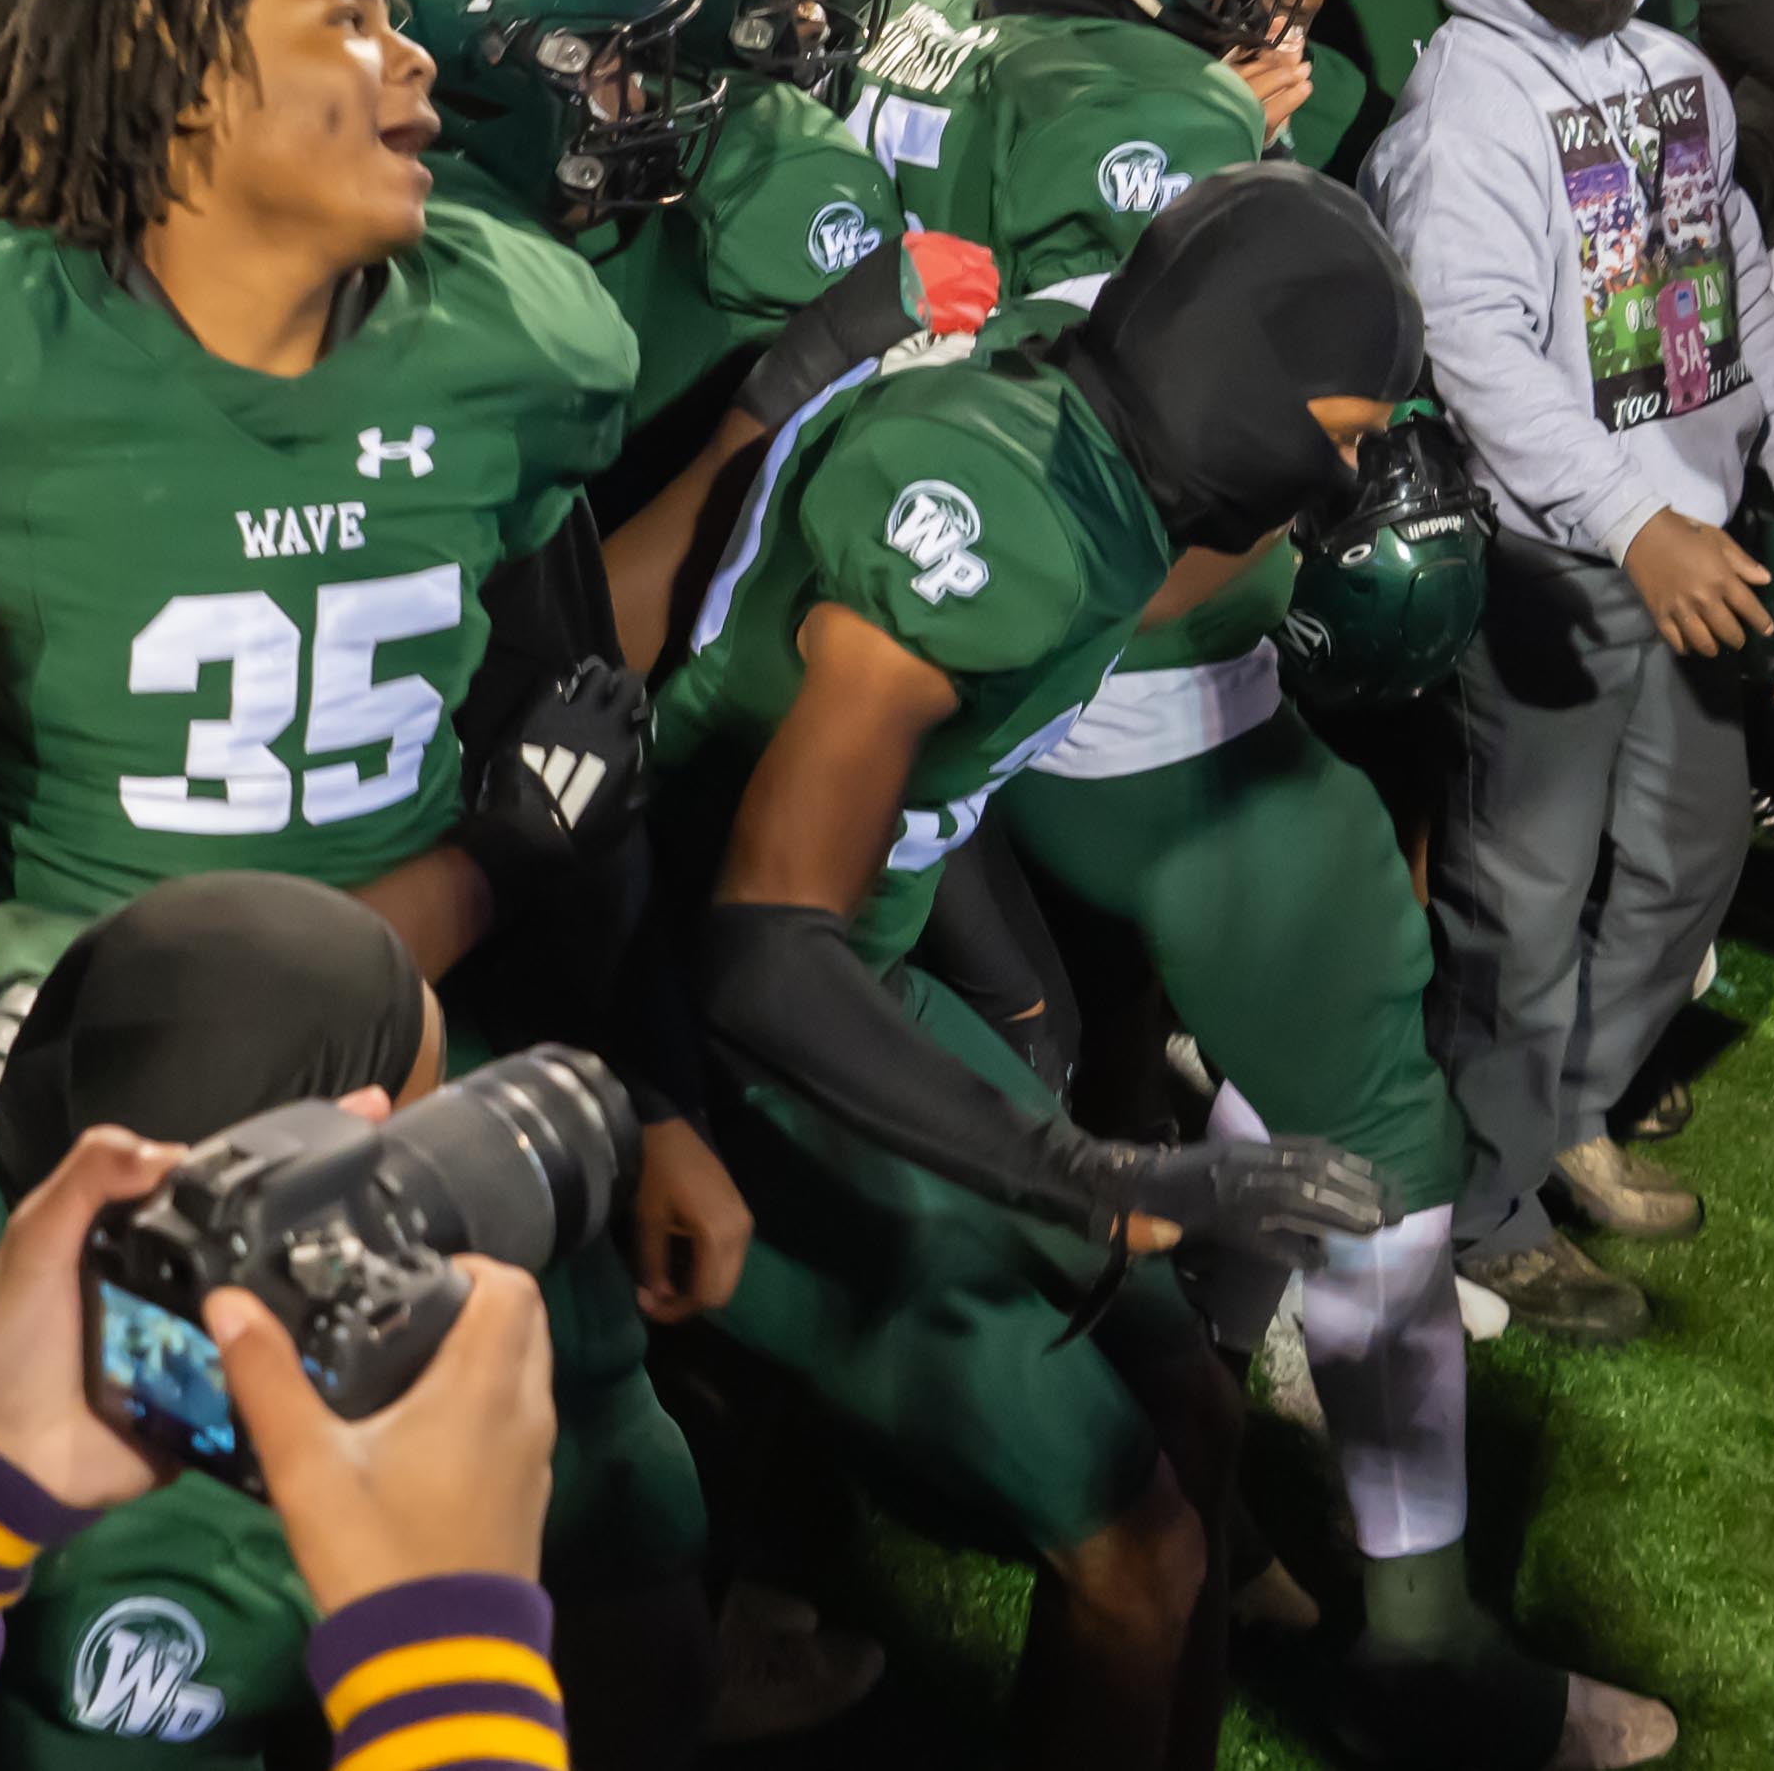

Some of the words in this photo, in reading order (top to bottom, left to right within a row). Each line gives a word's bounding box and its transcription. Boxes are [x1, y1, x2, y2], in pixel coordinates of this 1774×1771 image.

[234, 501, 367, 559] WAVE
[887, 479, 990, 605] WP
[119, 561, 462, 836] 35
